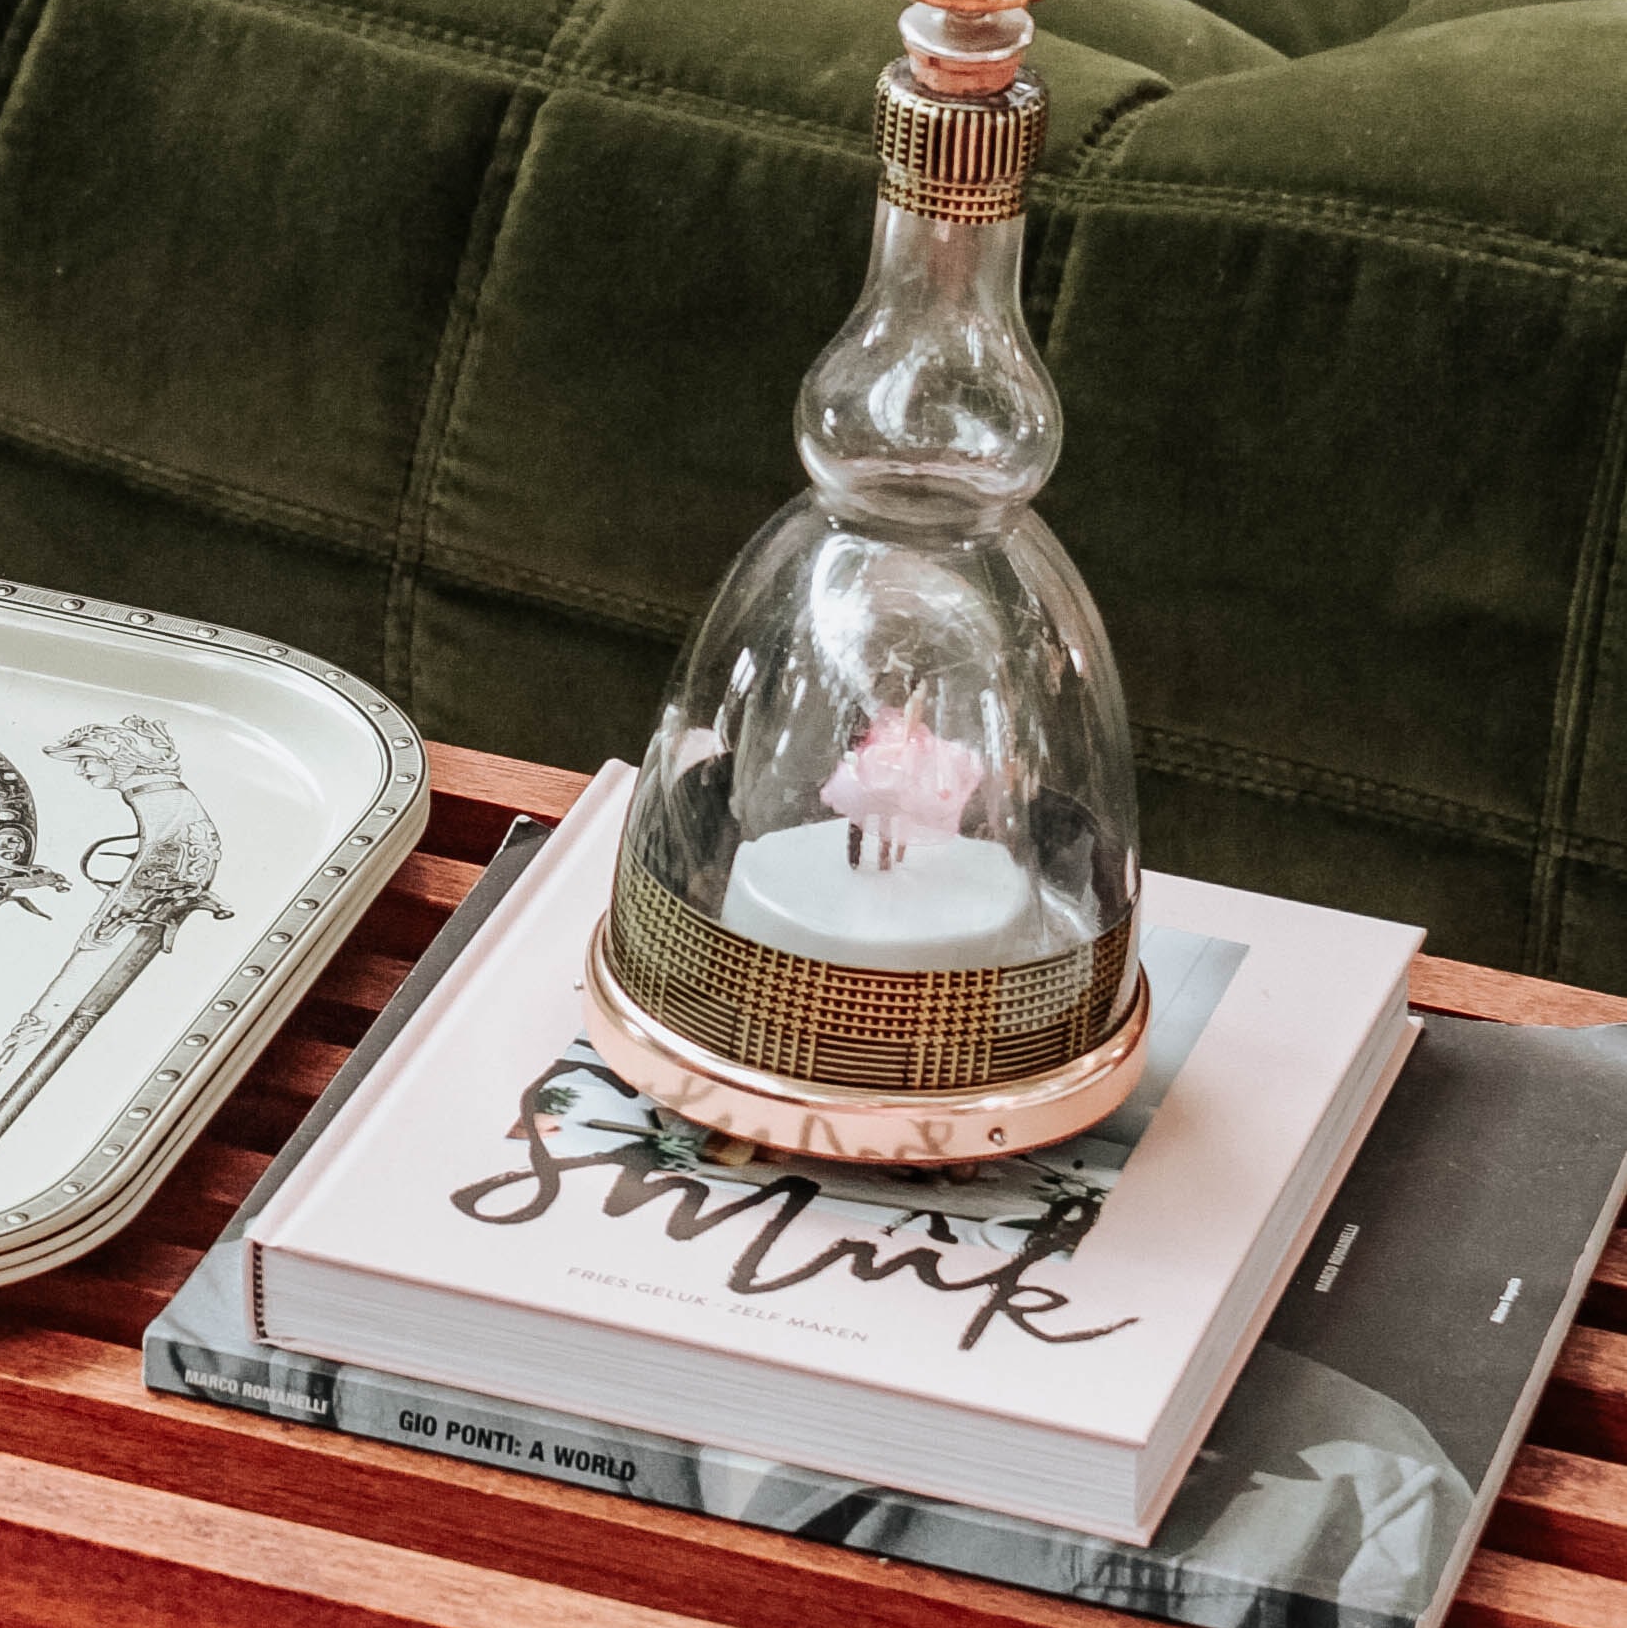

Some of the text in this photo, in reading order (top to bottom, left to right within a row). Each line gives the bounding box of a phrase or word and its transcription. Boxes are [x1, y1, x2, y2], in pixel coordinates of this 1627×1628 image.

[566, 1266, 629, 1289] FRIES
[635, 1282, 709, 1306] GELUK
[727, 1302, 782, 1321] ZELF
[785, 1316, 870, 1343] MAKEN
[184, 1369, 329, 1415] MARCO ROMANELLI
[398, 1410, 637, 1483] GIO PONTI: A WORLD
